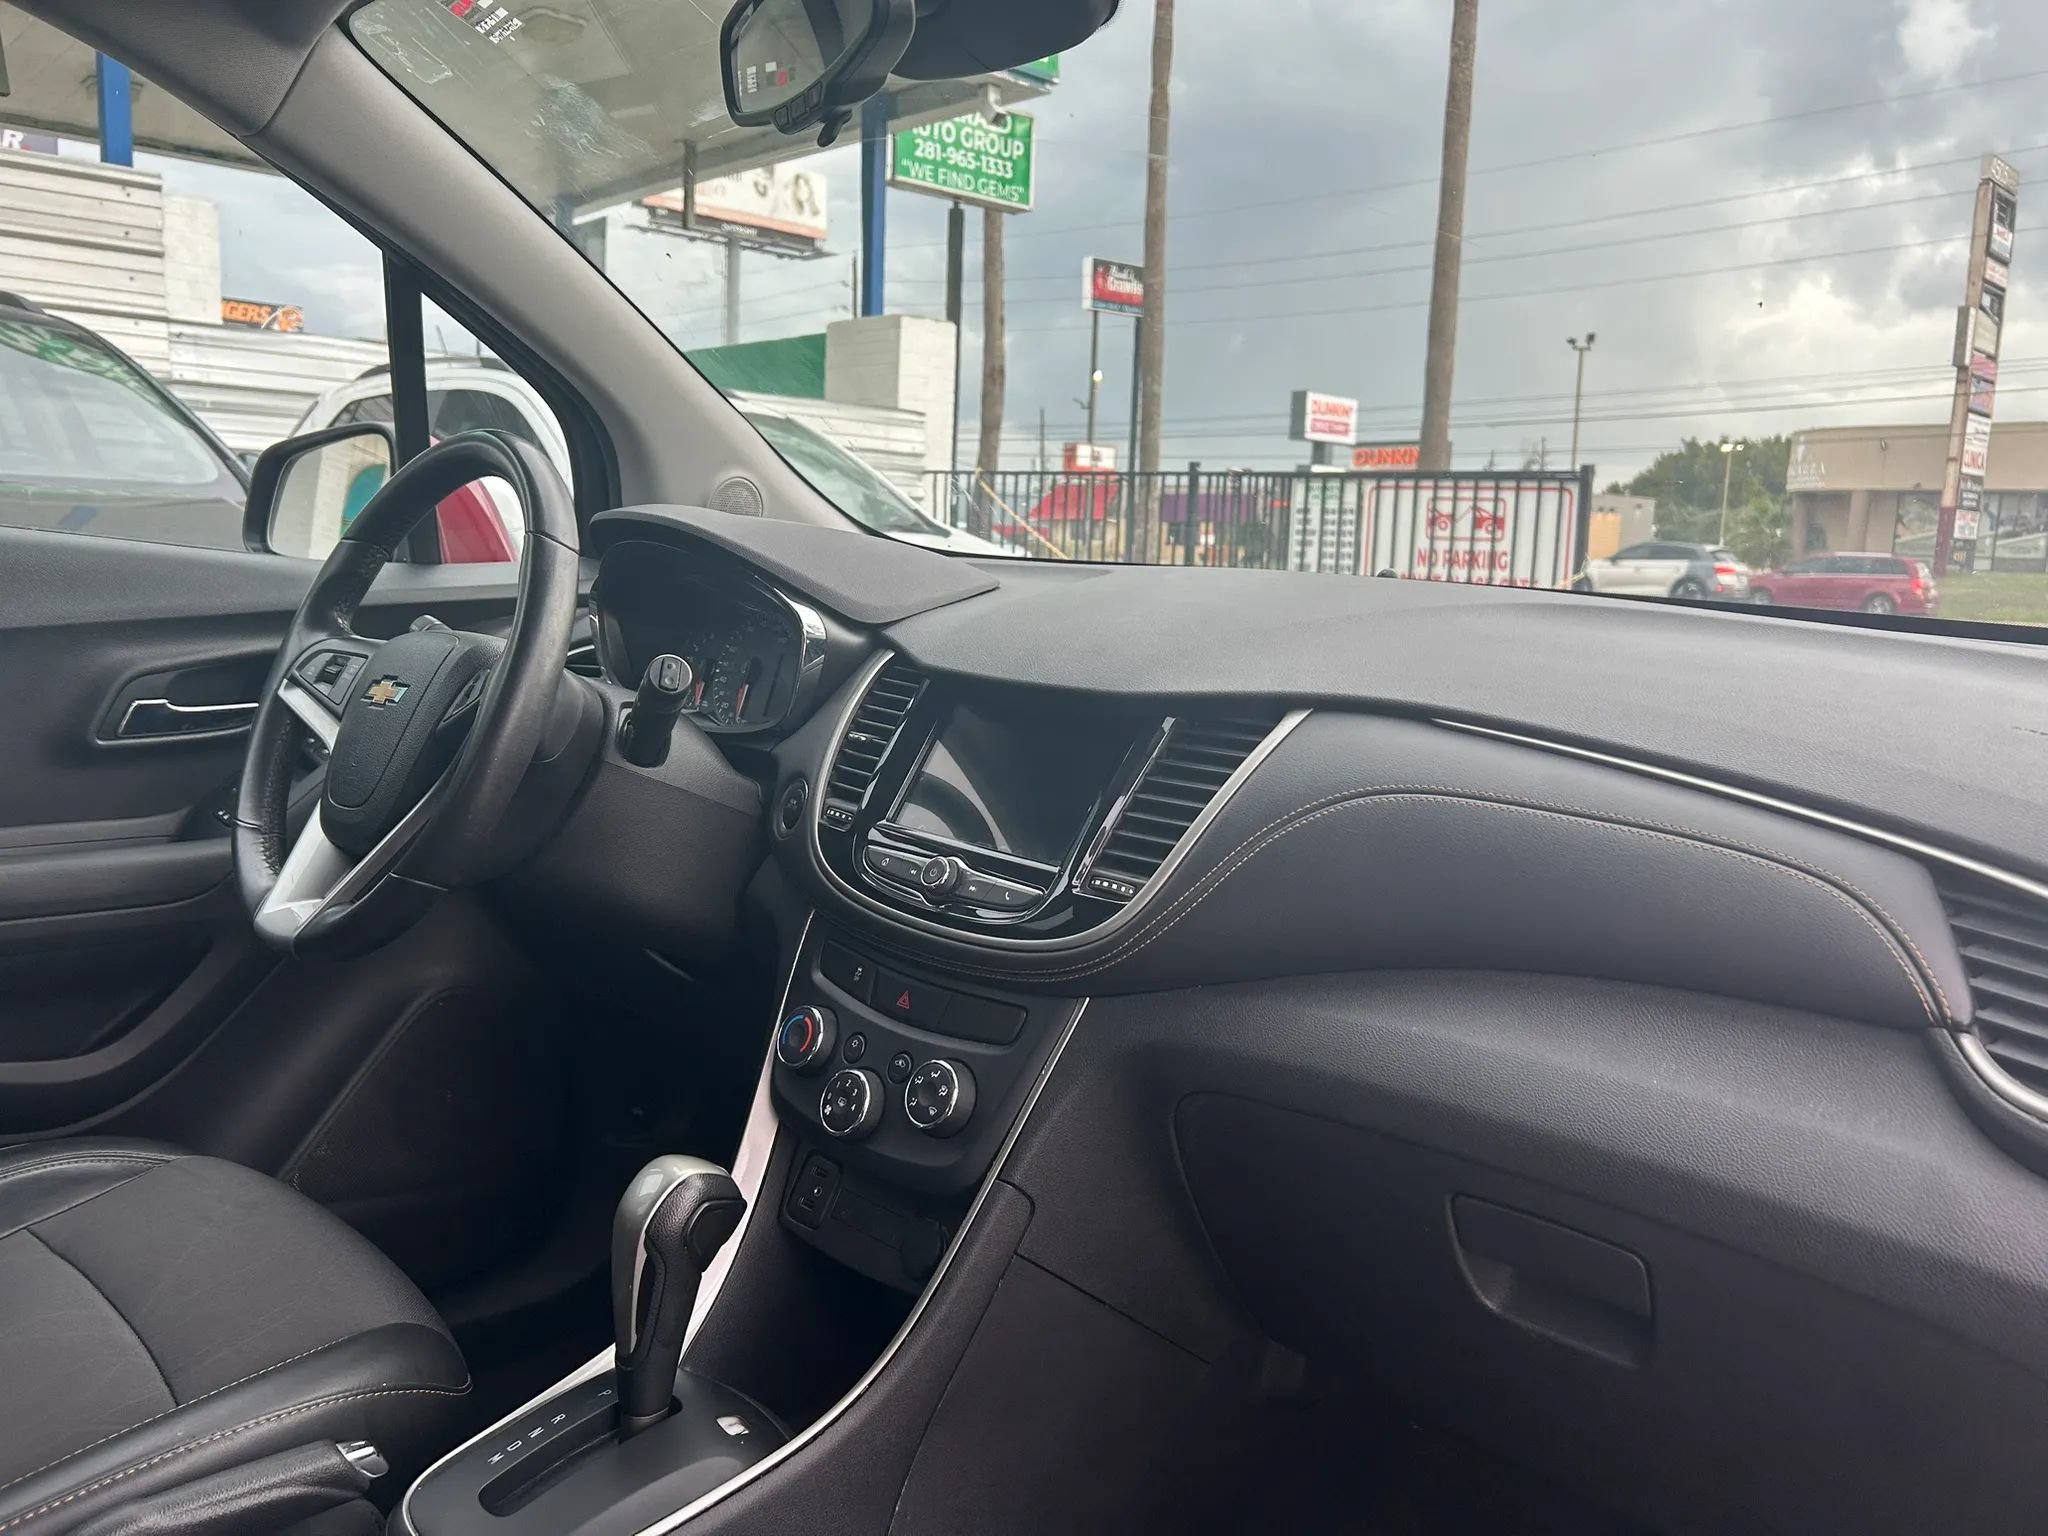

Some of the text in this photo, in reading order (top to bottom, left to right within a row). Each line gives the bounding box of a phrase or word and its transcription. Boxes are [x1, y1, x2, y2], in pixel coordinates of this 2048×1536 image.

[959, 127, 1025, 160] GROUP
[914, 138, 1014, 178] 281-965-1333
[937, 168, 976, 192] FIND
[1417, 549, 1508, 571] NO PARKING
[597, 1389, 612, 1397] P
[550, 1413, 566, 1424] R
[527, 1426, 544, 1438] N
[506, 1440, 522, 1451] D
